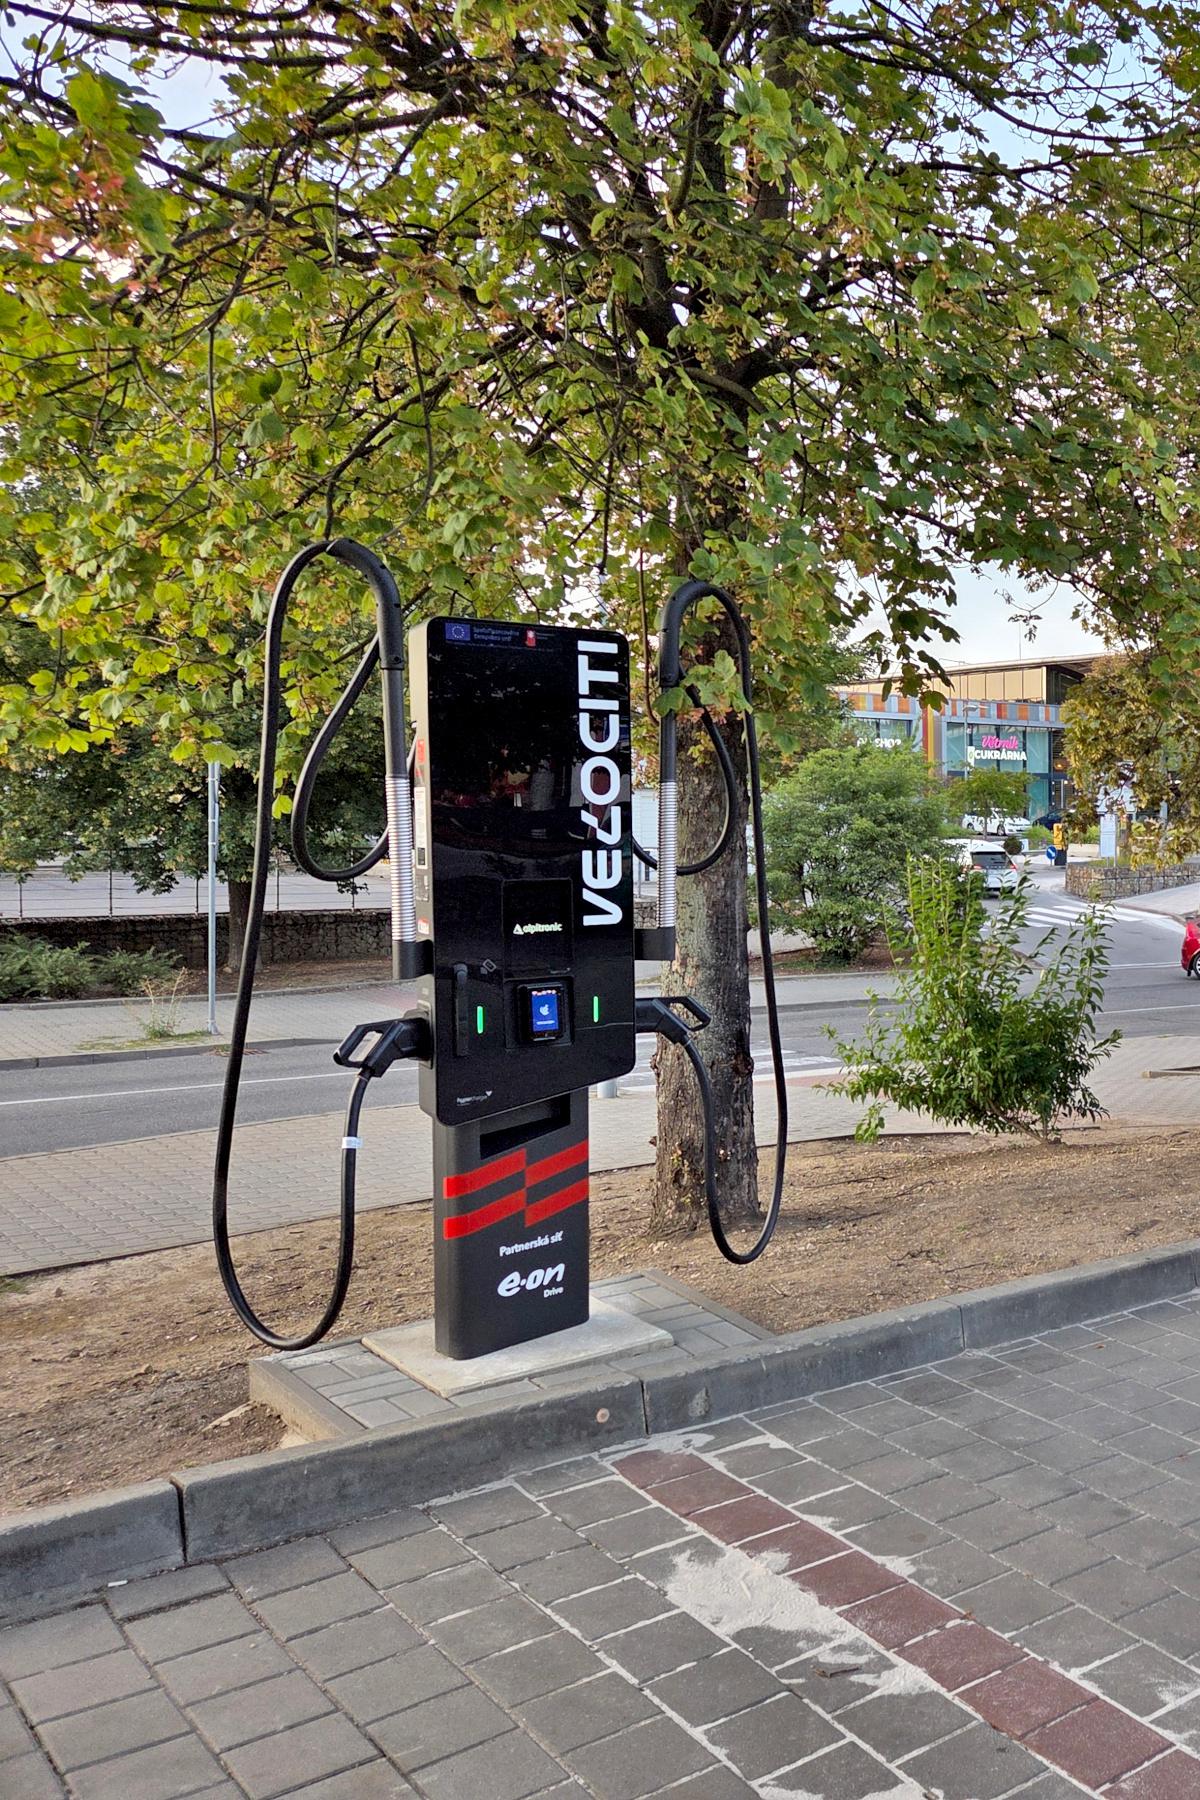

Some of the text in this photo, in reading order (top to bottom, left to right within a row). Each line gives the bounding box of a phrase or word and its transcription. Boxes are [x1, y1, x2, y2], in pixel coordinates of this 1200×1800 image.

[974, 748, 1027, 760] CUKRÁRNA
[577, 639, 623, 927] VELOCITI
[499, 1234, 550, 1257] Partnerská
[543, 1286, 564, 1298] Drive
